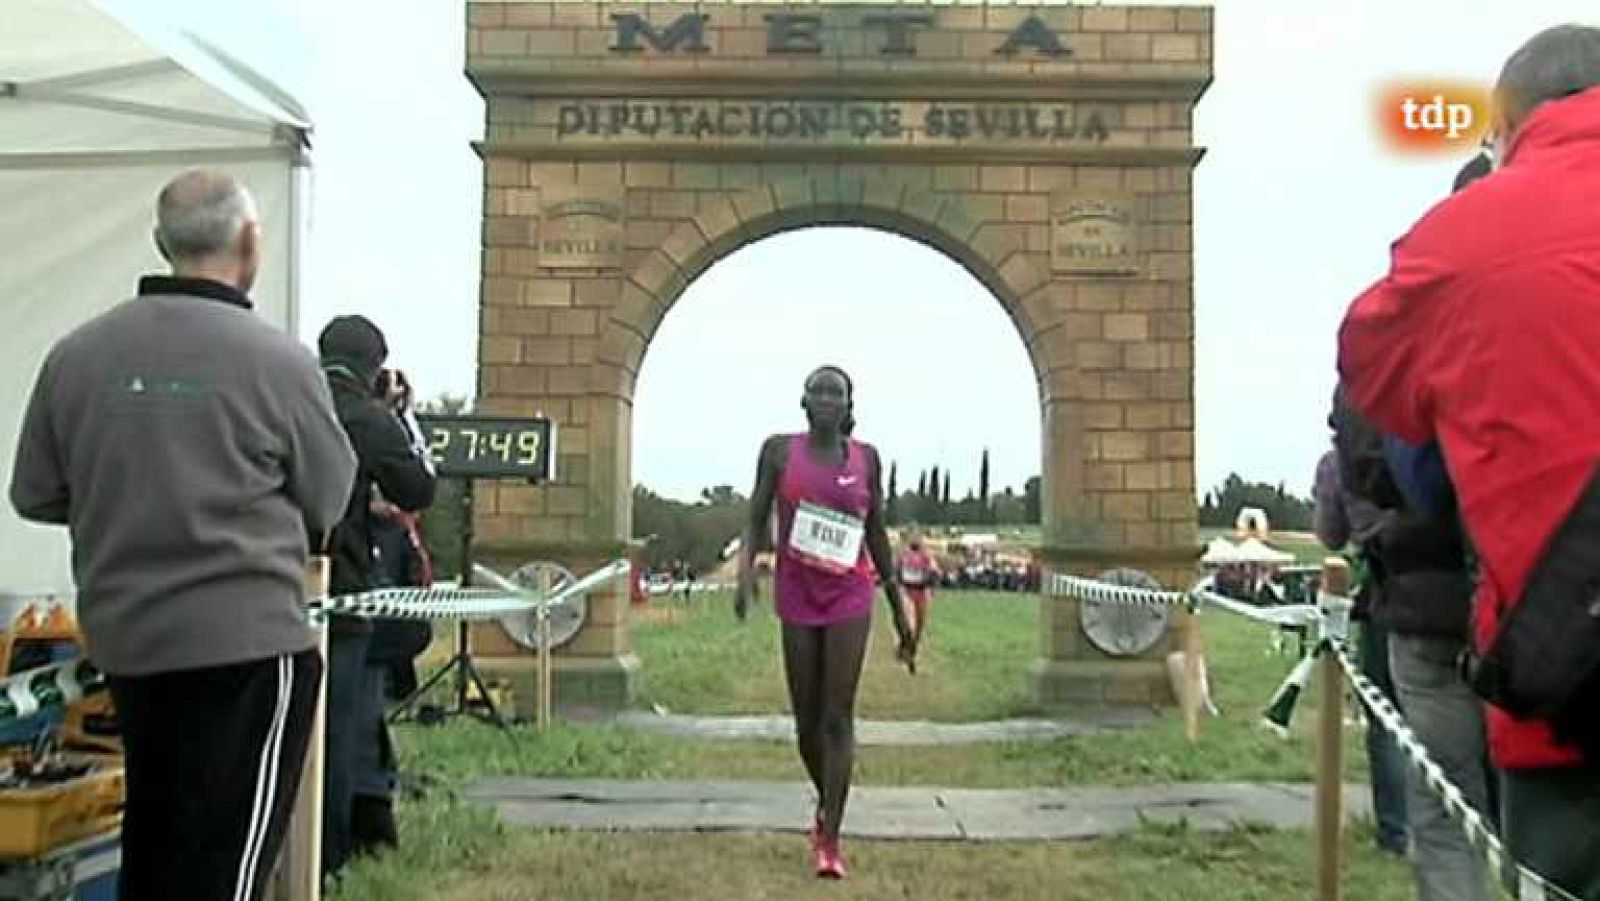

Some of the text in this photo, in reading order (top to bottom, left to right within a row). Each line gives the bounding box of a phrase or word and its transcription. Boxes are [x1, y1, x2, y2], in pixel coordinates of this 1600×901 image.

[607, 12, 1073, 56] META
[557, 99, 1110, 141] DIPUTACIÓN DE SEVILLA
[429, 427, 541, 464] 27:49
